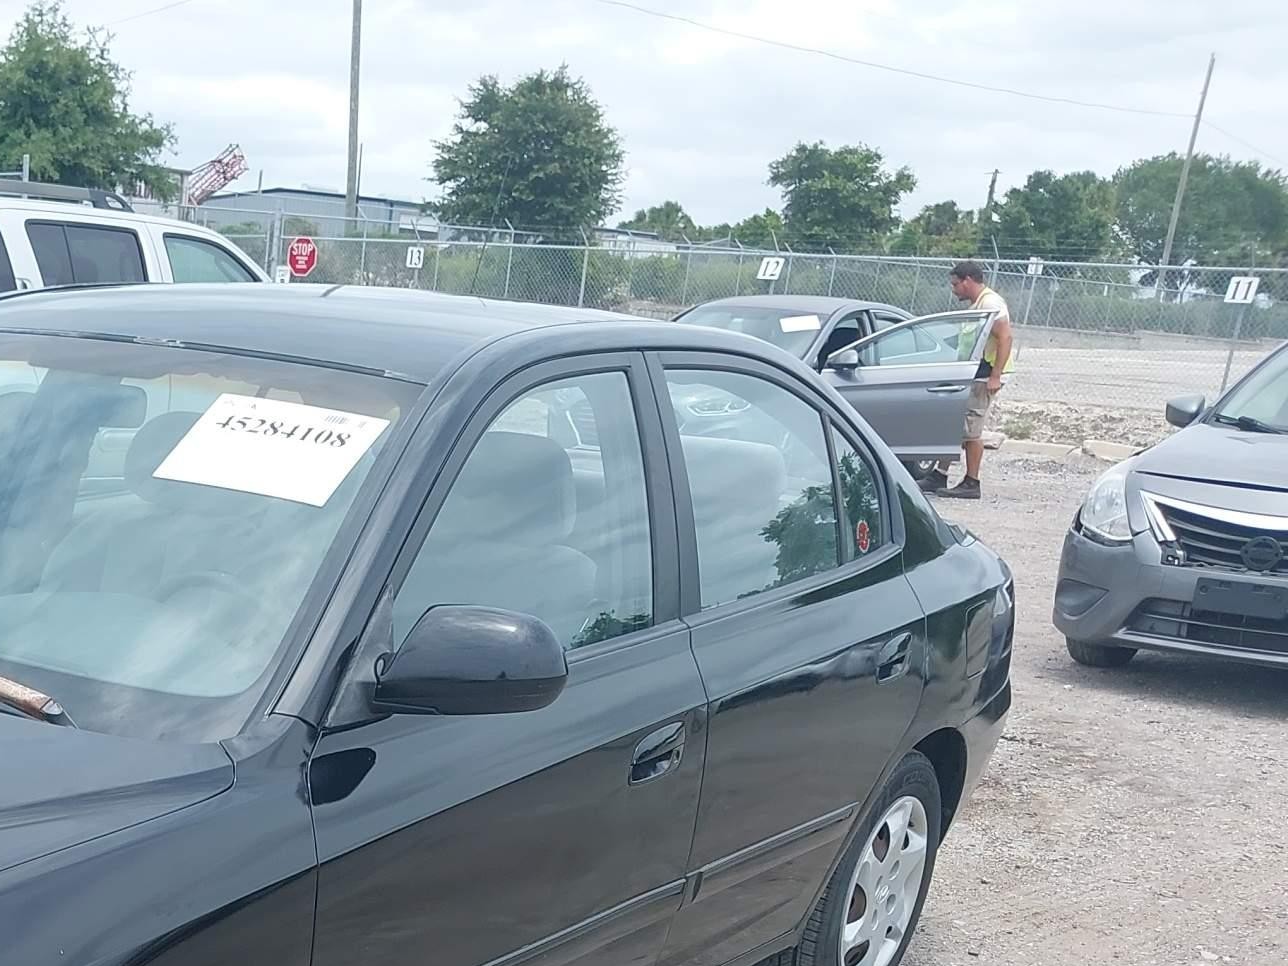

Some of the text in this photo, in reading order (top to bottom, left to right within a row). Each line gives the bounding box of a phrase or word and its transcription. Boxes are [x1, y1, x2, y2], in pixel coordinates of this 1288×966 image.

[291, 243, 314, 256] STOP
[409, 249, 422, 266] 13
[762, 261, 780, 277] 12
[1230, 280, 1254, 301] 11
[215, 415, 351, 448] 45284108
